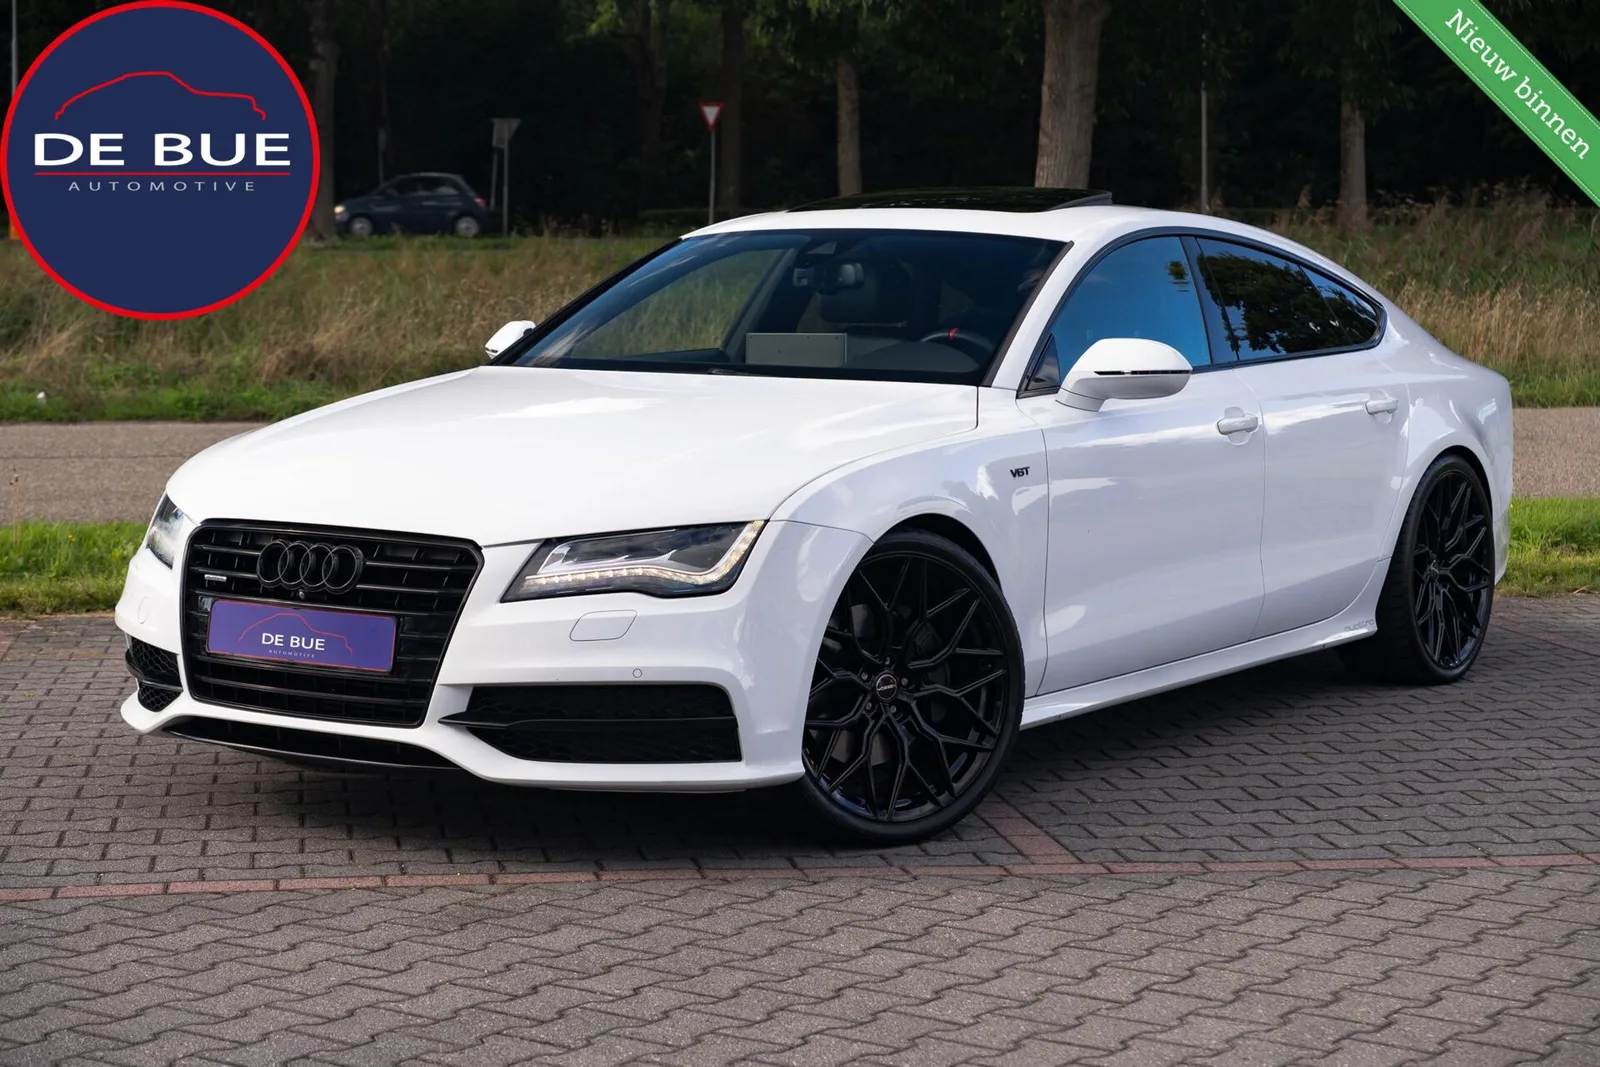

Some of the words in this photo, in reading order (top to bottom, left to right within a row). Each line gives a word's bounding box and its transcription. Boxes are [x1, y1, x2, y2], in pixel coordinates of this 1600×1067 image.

[261, 632, 284, 646] DE
[290, 635, 325, 651] BUE
[268, 649, 315, 658] AUTOMOTIVE
